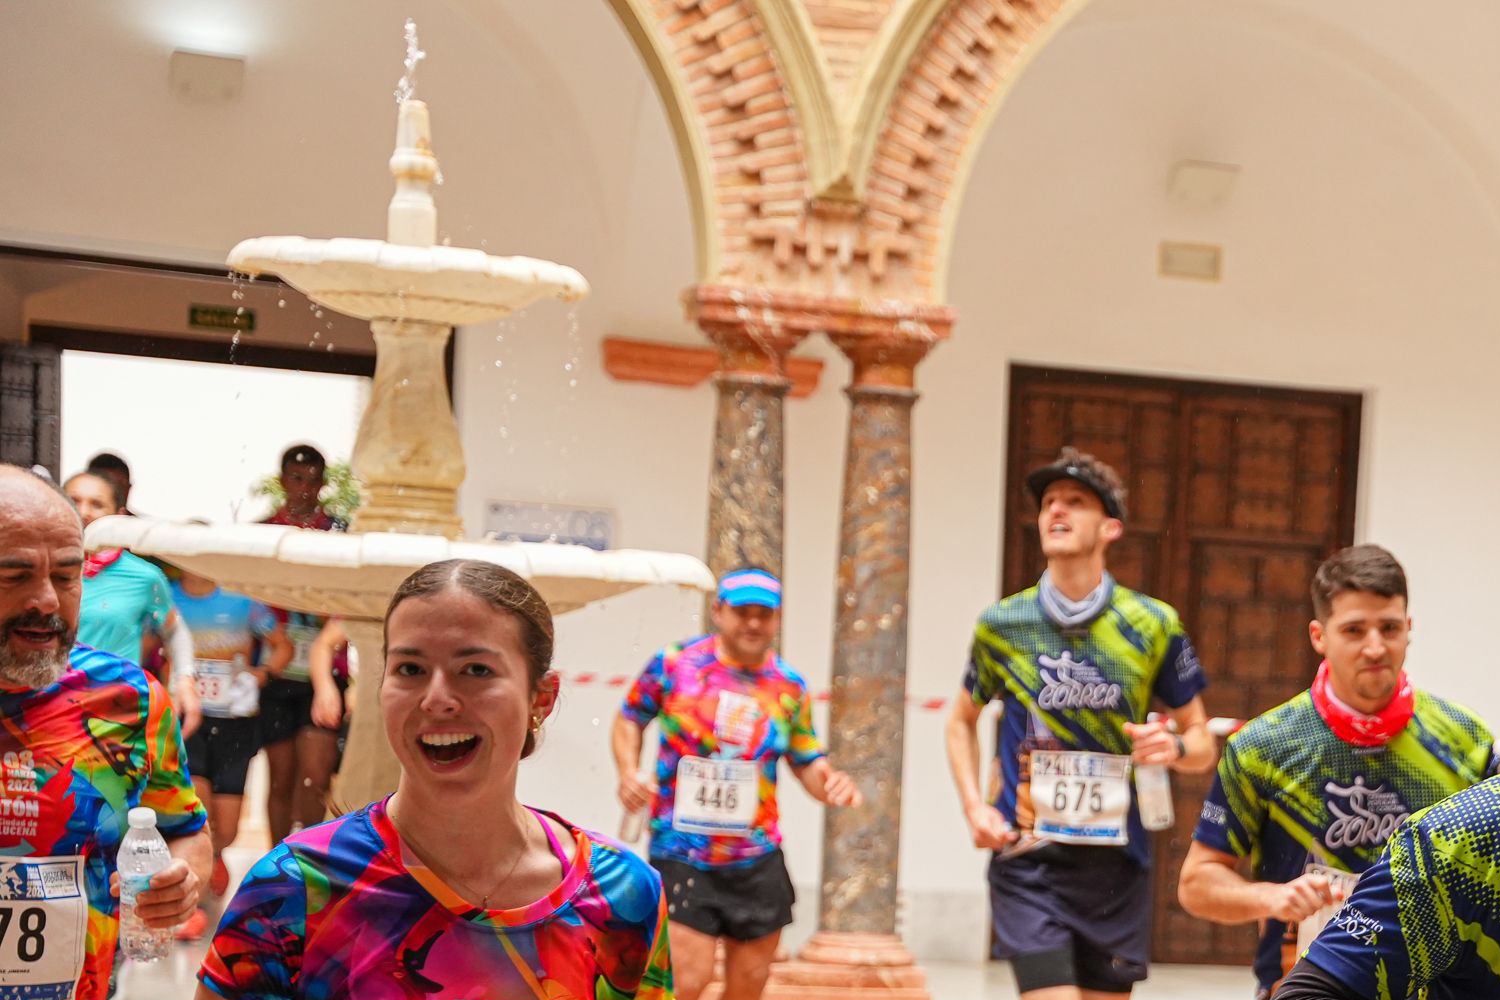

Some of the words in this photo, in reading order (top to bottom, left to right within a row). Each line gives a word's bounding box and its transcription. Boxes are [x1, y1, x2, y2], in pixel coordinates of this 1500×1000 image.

[1038, 682, 1121, 711] CORRER
[4, 750, 35, 770] 08
[8, 780, 38, 792] 2026
[695, 784, 738, 812] 446
[1053, 781, 1103, 813] 675
[0, 795, 39, 817] TÓN
